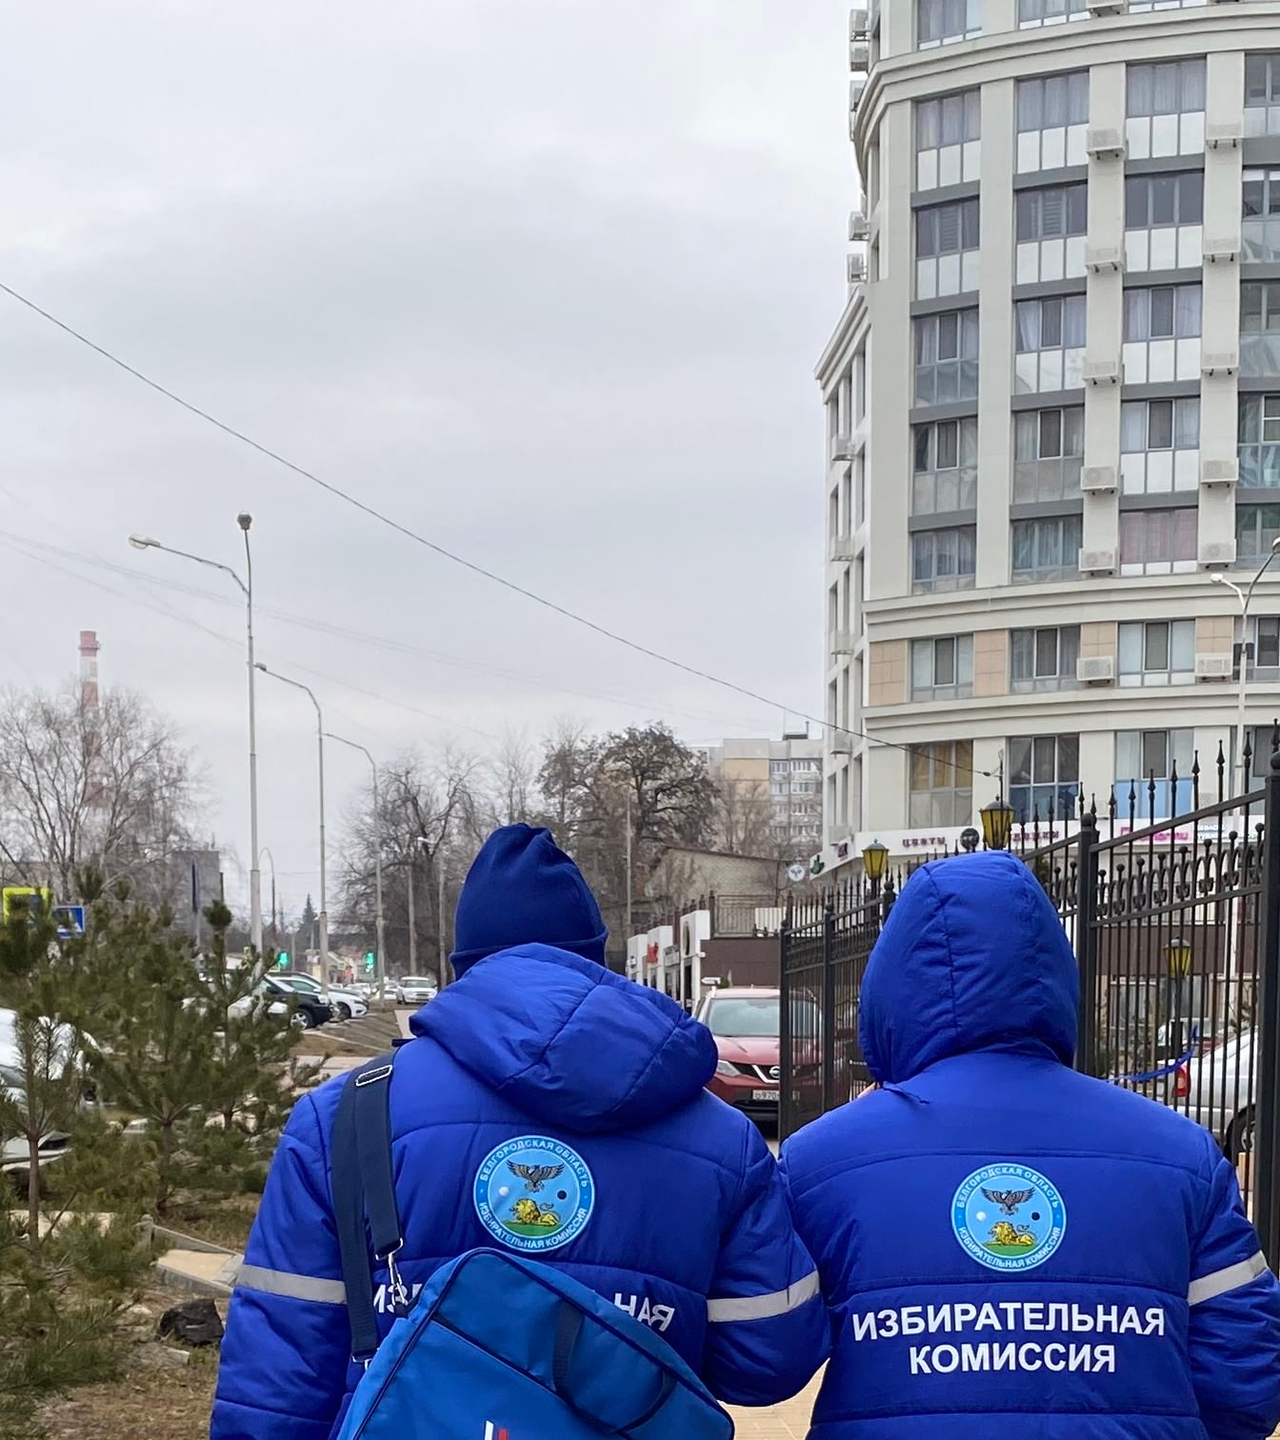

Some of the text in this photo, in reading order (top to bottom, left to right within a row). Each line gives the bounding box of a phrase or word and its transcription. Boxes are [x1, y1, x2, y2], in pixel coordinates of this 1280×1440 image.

[480, 1139, 589, 1187] БЕЛГОРОДСКАЯ ОБЛАСТЬ
[956, 1167, 1060, 1208] БЕЛГОРОДСКАЯ ОБЛАСТЬ
[479, 1202, 587, 1248] ИЗБИРАТЕЛЬНАЯ КОМИССИЯ
[958, 1227, 1061, 1268] ИЗБИРАТЕЛЬНАЯ КОМИССИЯ
[852, 1302, 1165, 1341] ИЗБИРАТЕЛЬНАЯ
[909, 1342, 1116, 1375] КОМИССИЯ
